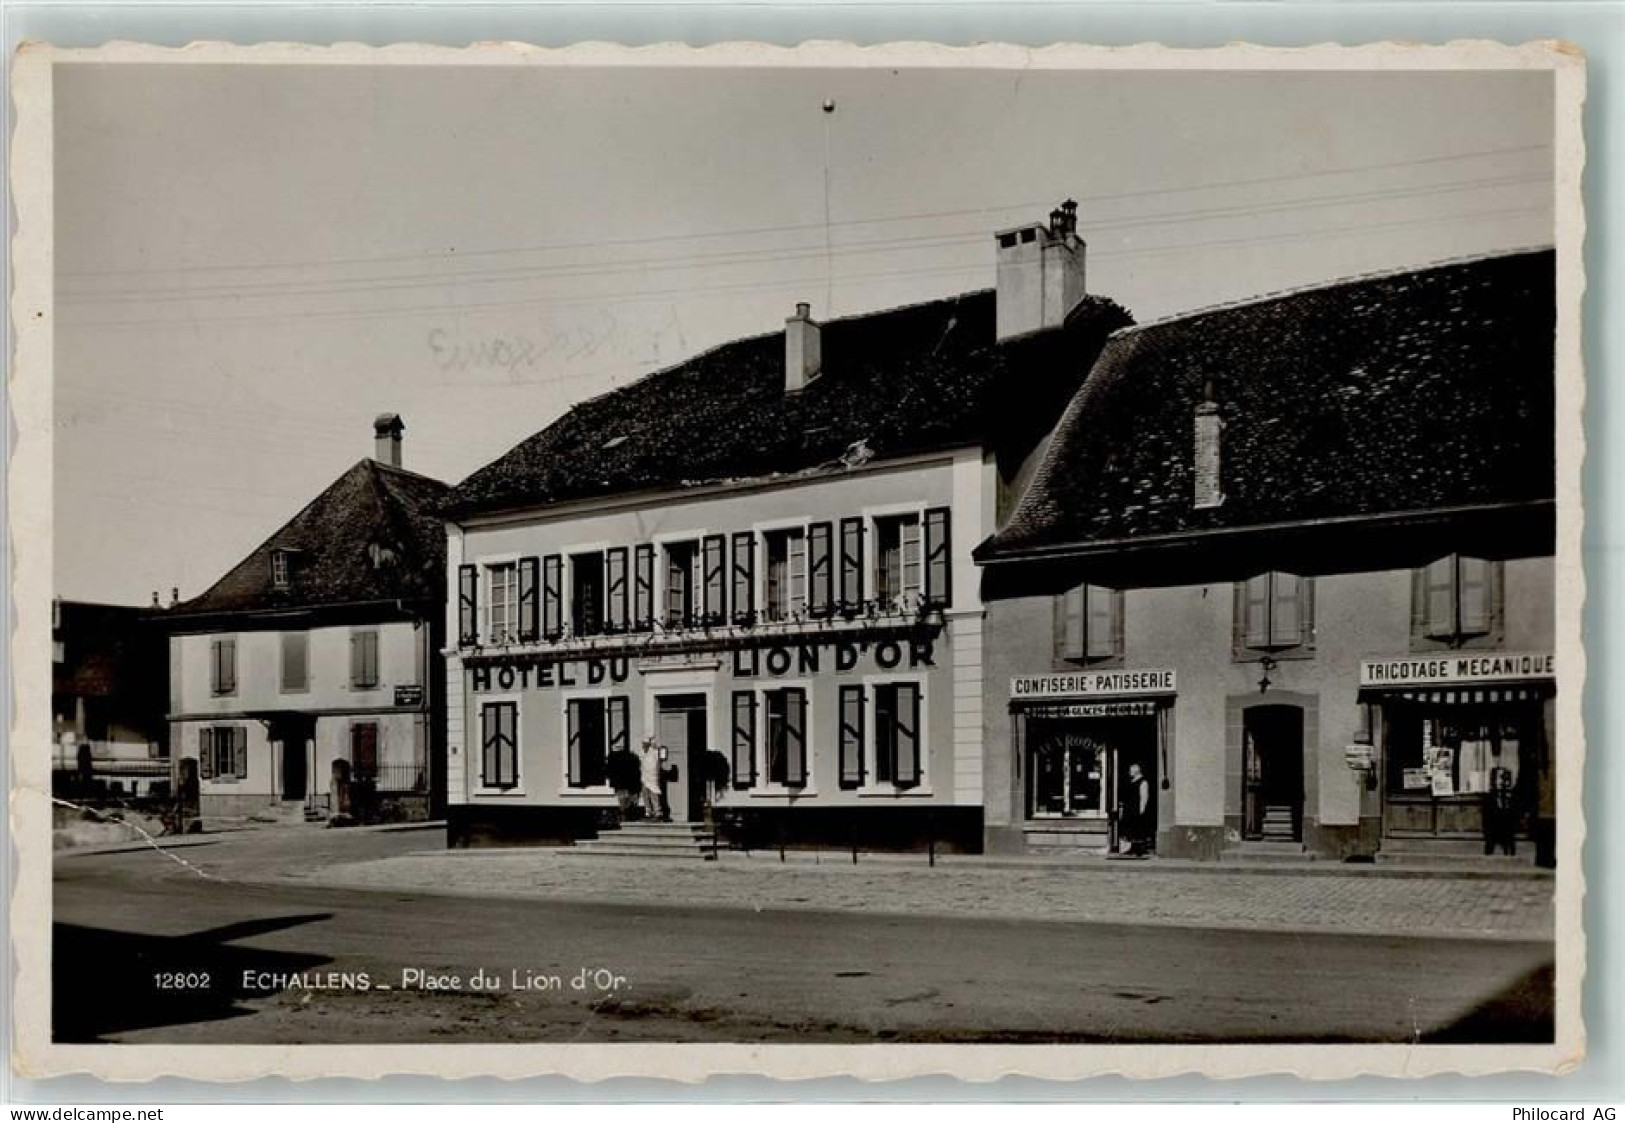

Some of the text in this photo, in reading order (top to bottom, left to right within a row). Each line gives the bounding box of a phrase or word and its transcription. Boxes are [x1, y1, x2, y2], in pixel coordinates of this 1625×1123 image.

[587, 656, 629, 684] DU
[733, 640, 820, 677] LION
[1367, 656, 1554, 680] TRICOTAGE MECANIQUE
[1016, 676, 1087, 693] CONFISERIE
[1096, 671, 1173, 690] PATISSERIE
